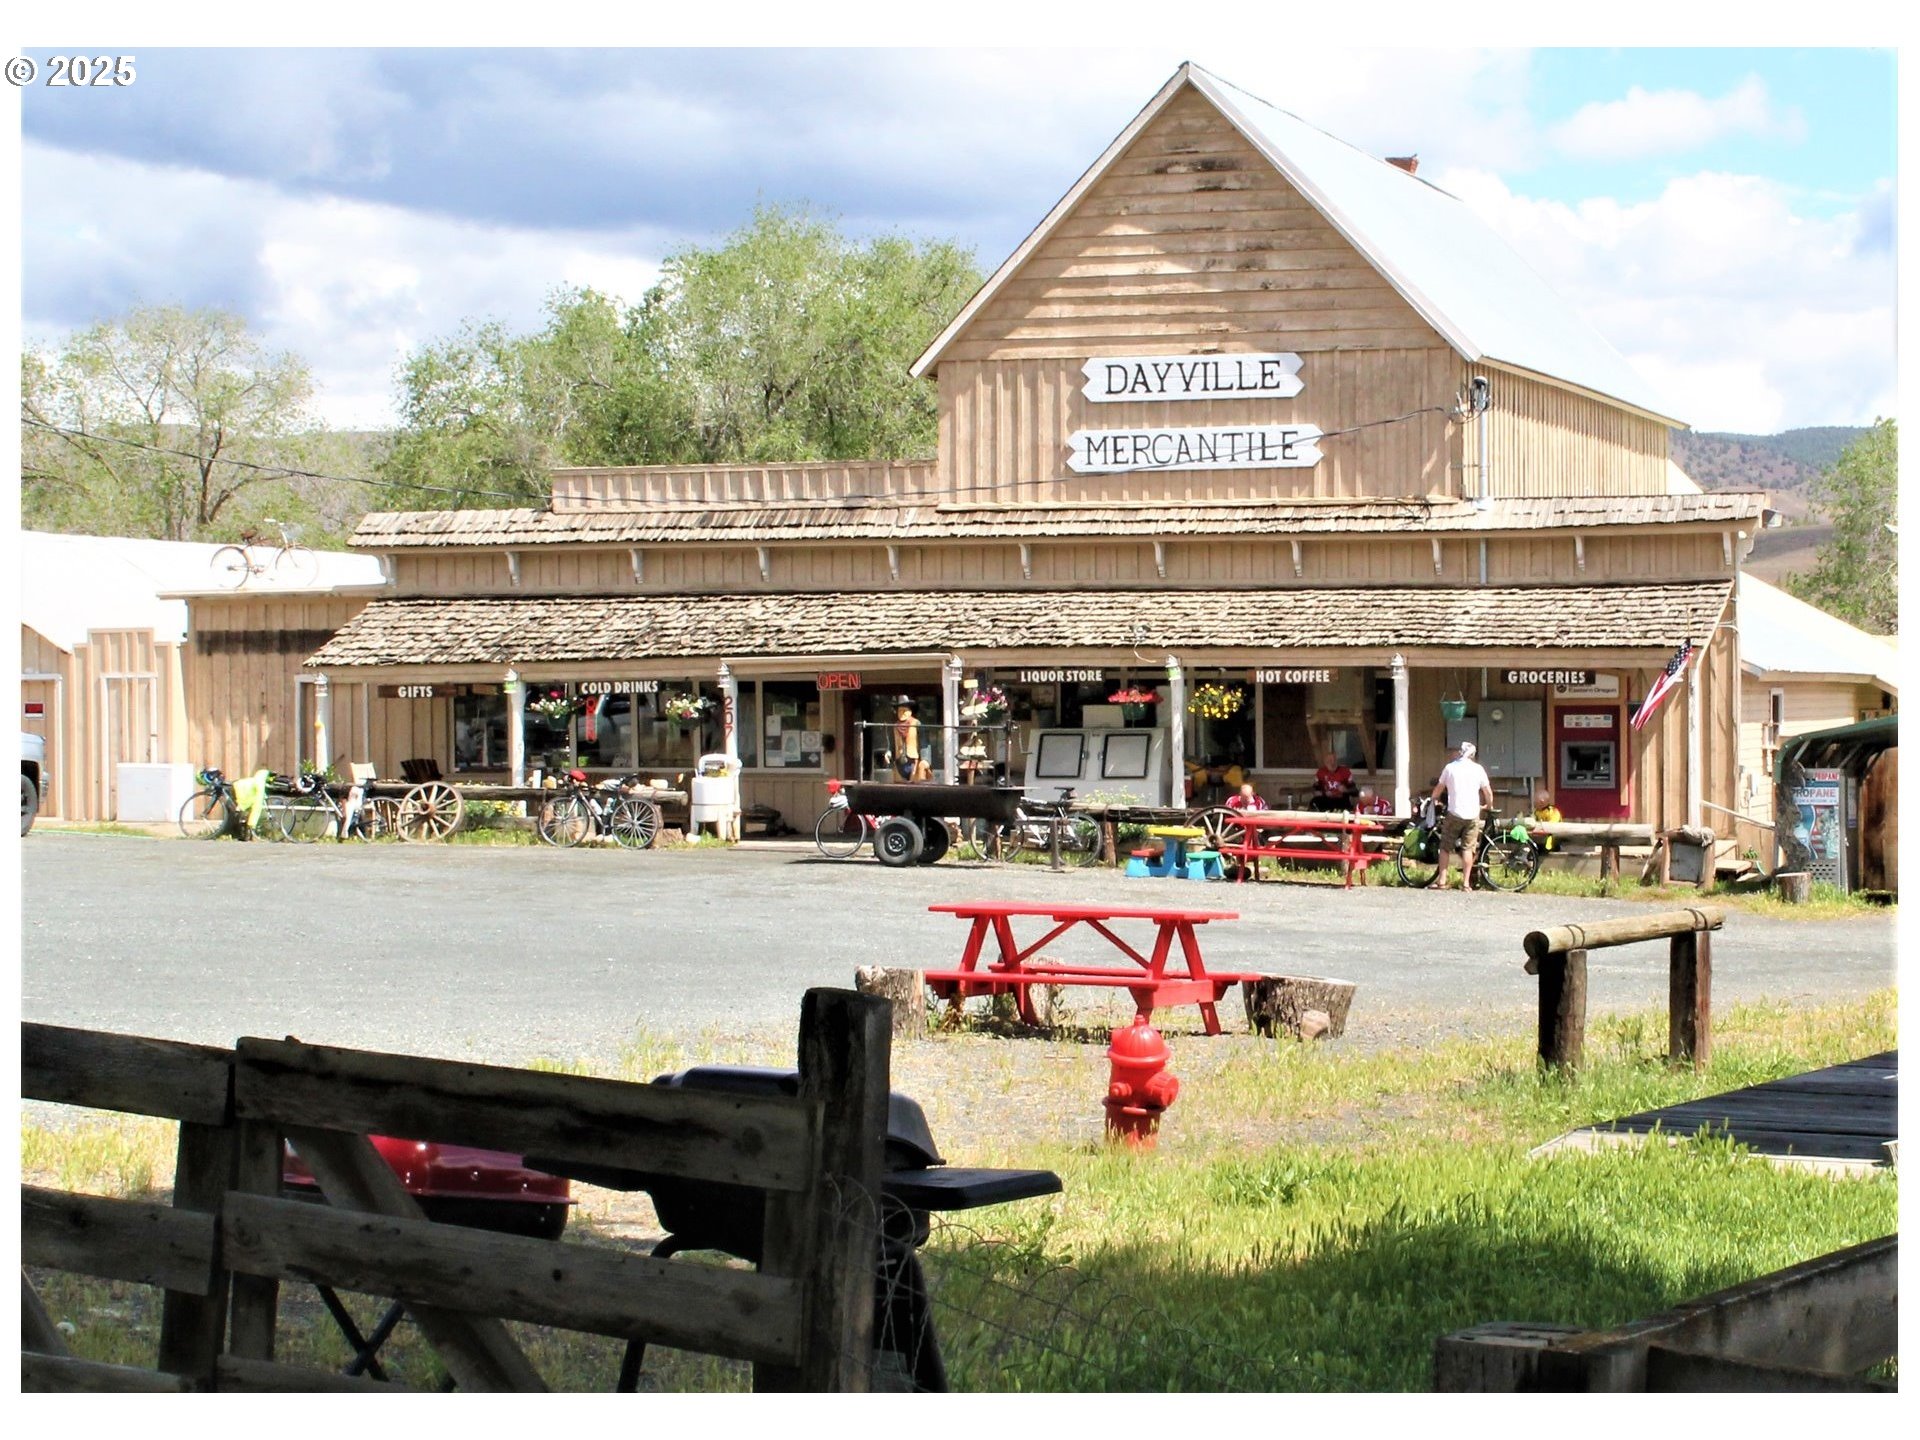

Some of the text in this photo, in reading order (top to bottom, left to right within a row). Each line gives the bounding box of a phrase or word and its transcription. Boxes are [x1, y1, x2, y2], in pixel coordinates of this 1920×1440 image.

[1105, 360, 1281, 395] DAYVILLE
[1085, 430, 1299, 466] MERCANTILE
[818, 673, 859, 689] OPEN
[1020, 670, 1102, 683] LIQUOR STORE
[1255, 670, 1330, 683] HOT COFFEE
[1507, 670, 1586, 684] GROCERIES
[397, 686, 433, 698] GIFTS
[581, 681, 658, 694] COLD DRINKS
[723, 696, 733, 740] 207
